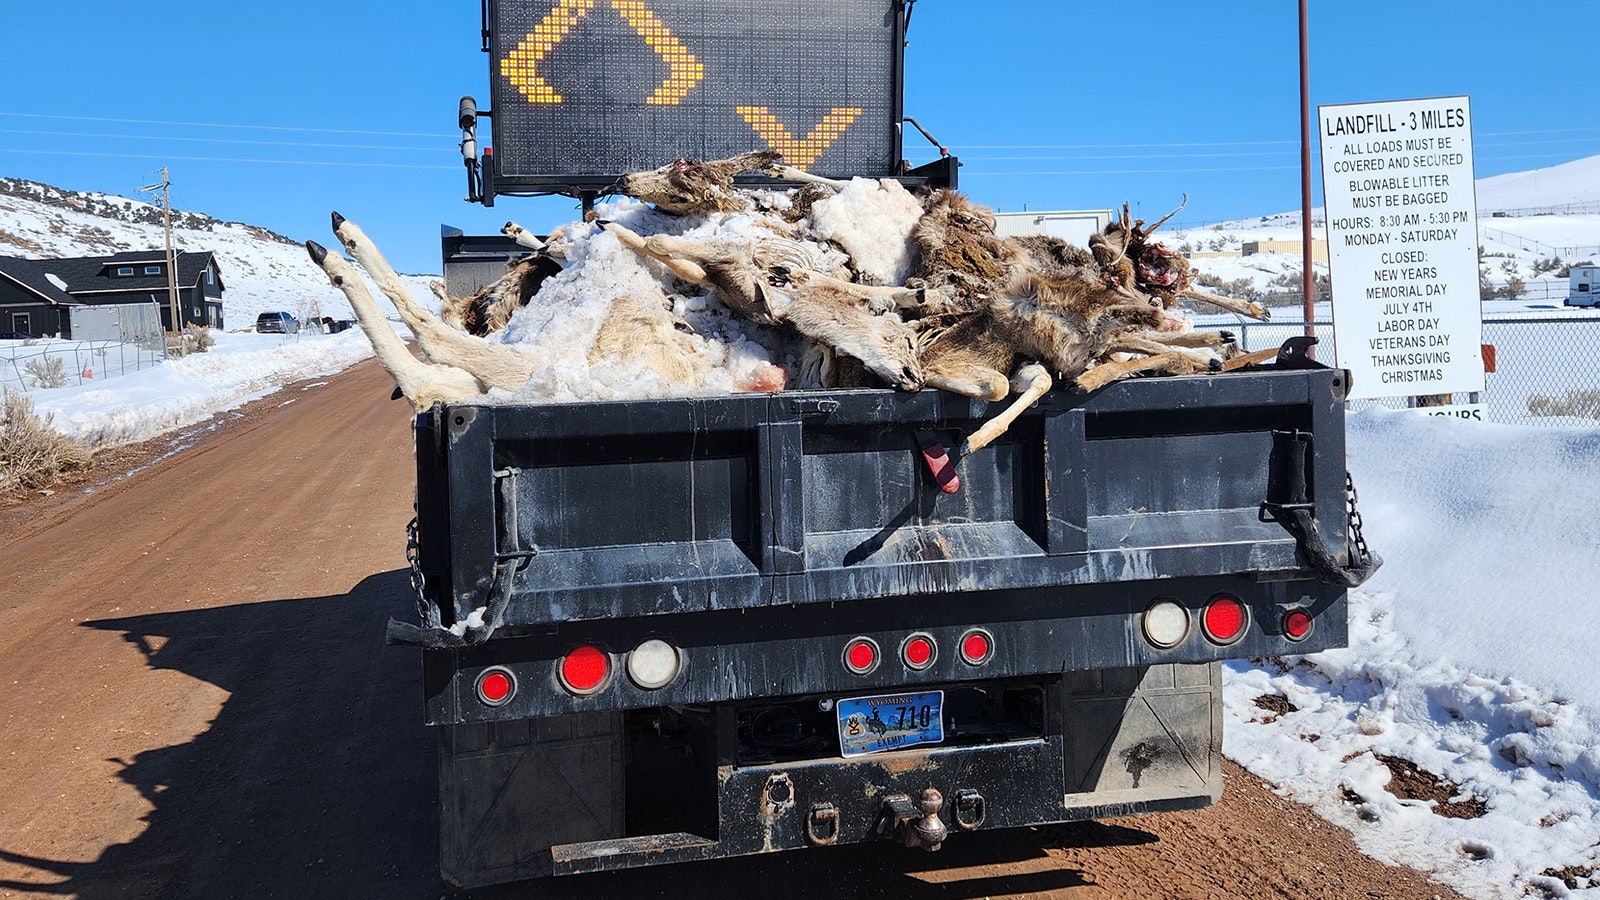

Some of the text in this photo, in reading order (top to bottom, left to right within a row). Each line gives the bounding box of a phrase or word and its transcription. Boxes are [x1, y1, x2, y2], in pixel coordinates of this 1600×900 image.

[1327, 113, 1397, 136] LANDFILL
[1409, 112, 1417, 130] 3
[1421, 108, 1464, 130] MILES
[1344, 137, 1452, 155] ALL LOADS MUST BE
[1334, 153, 1463, 173] COVERED AND SECURED
[1350, 175, 1449, 192] BLOWABLE LITTER
[1353, 192, 1448, 208] MUST BE BAGGED
[1333, 217, 1374, 230] HOURS:
[1380, 215, 1400, 227] 8:30
[1404, 214, 1420, 226] AM
[1430, 212, 1450, 224] 5:30
[1453, 211, 1468, 223] PM
[1345, 232, 1391, 246] MONDAY
[1401, 229, 1457, 243] SATURDAY
[1382, 251, 1428, 264] CLOSED:
[1374, 267, 1437, 281] NEW YEARS
[1366, 284, 1447, 299] MEMORIAL DAY
[1383, 301, 1432, 315] JULY 4TH
[1378, 318, 1439, 332] LABOR DAY
[1369, 334, 1450, 350] VETERANS DAY
[1371, 351, 1450, 367] THANKSGIVING
[1382, 369, 1442, 383] CHRISTMAS
[868, 697, 912, 706] WYOMING
[896, 705, 931, 731] 710
[877, 735, 907, 747] EXEMPT
